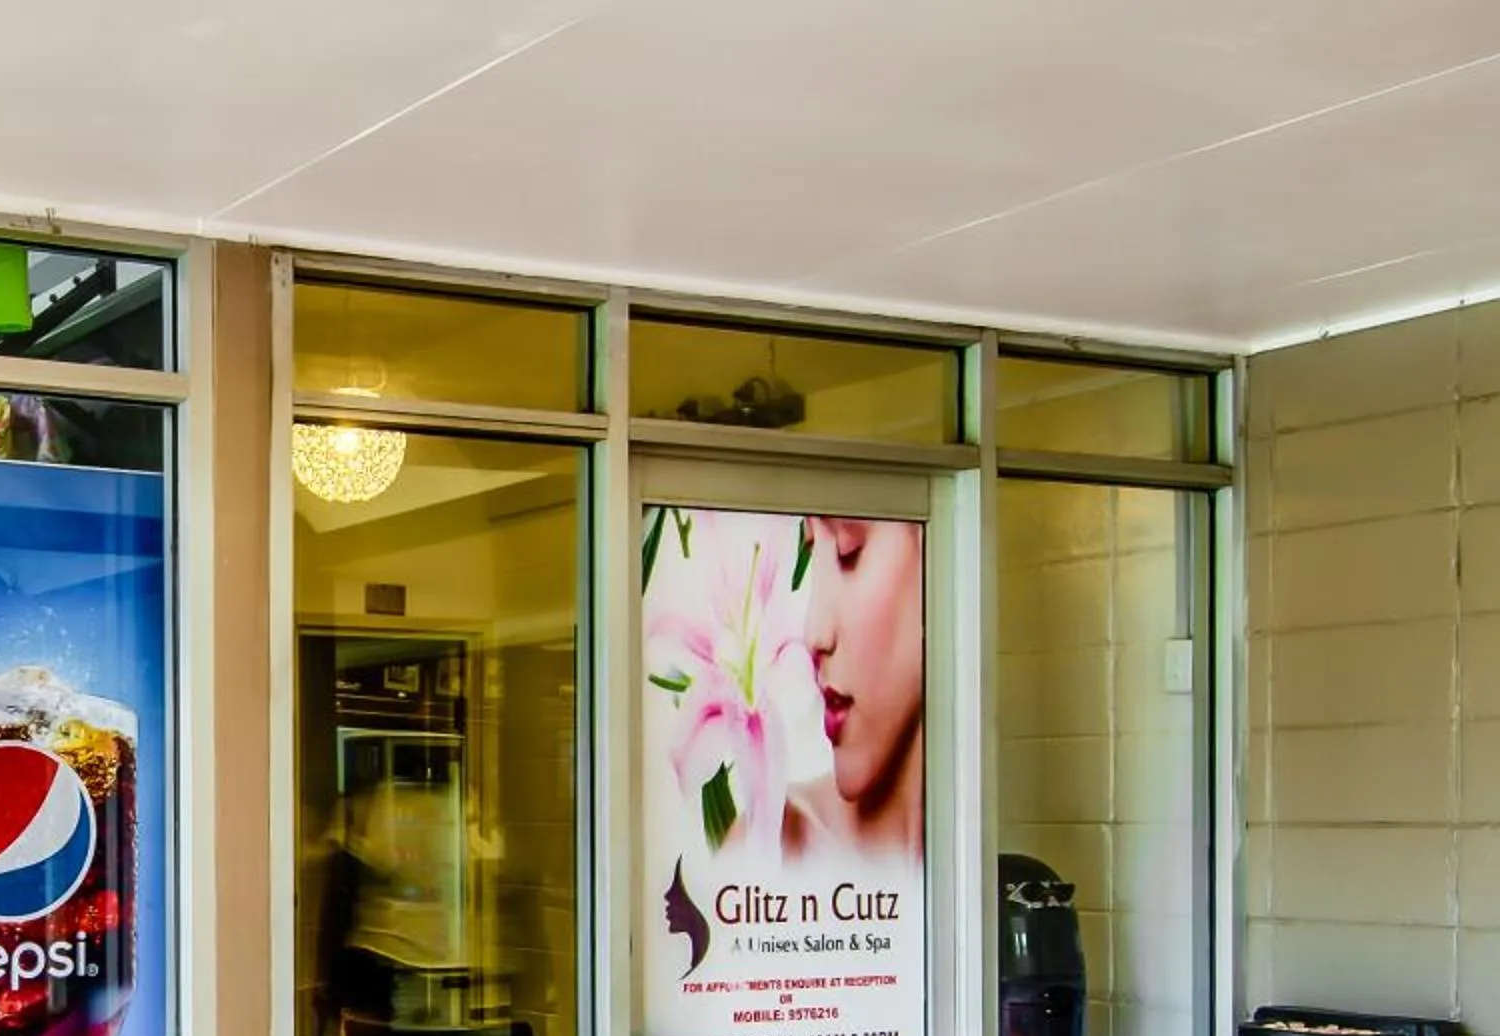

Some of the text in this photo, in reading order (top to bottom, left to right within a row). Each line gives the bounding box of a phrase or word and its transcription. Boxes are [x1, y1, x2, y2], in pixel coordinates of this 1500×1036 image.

[715, 883, 899, 924] Glitz n Cutz
[749, 935, 799, 952] Unisex
[804, 934, 844, 952] Salon
[849, 933, 861, 951] &
[865, 932, 891, 953] Spa
[683, 983, 703, 993] FOR
[830, 977, 841, 987] AT
[844, 975, 897, 986] RECEPTION
[779, 994, 792, 1005] OR
[733, 1007, 839, 1022] MOBILE: 9576216
